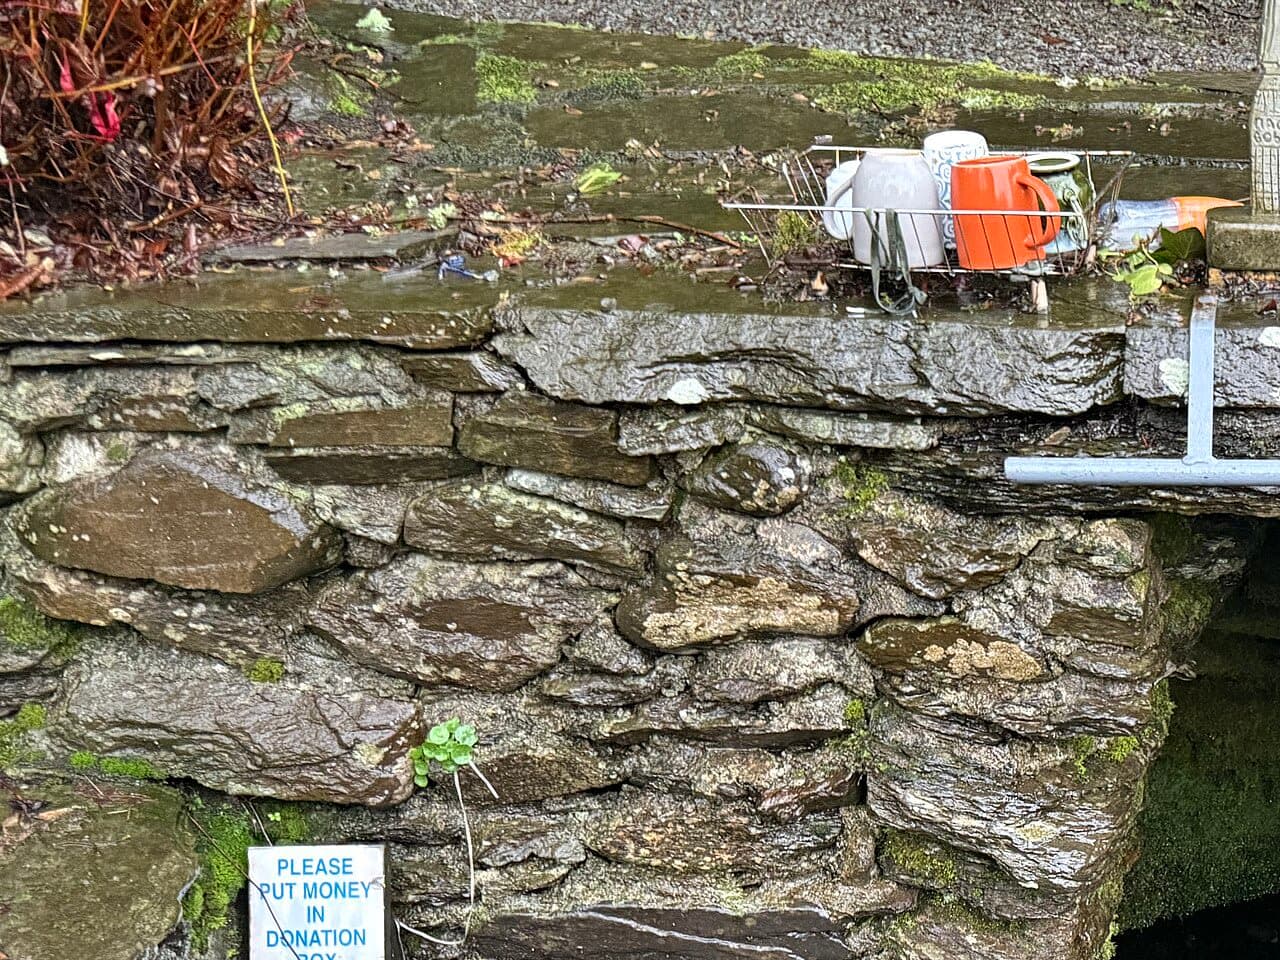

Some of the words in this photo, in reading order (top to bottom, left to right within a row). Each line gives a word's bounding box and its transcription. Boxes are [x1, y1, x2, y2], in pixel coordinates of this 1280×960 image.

[277, 858, 353, 875] PLEASE
[259, 882, 296, 899] PUT
[303, 881, 371, 899] MONEY
[306, 905, 324, 923] IN
[266, 928, 366, 947] DONATION
